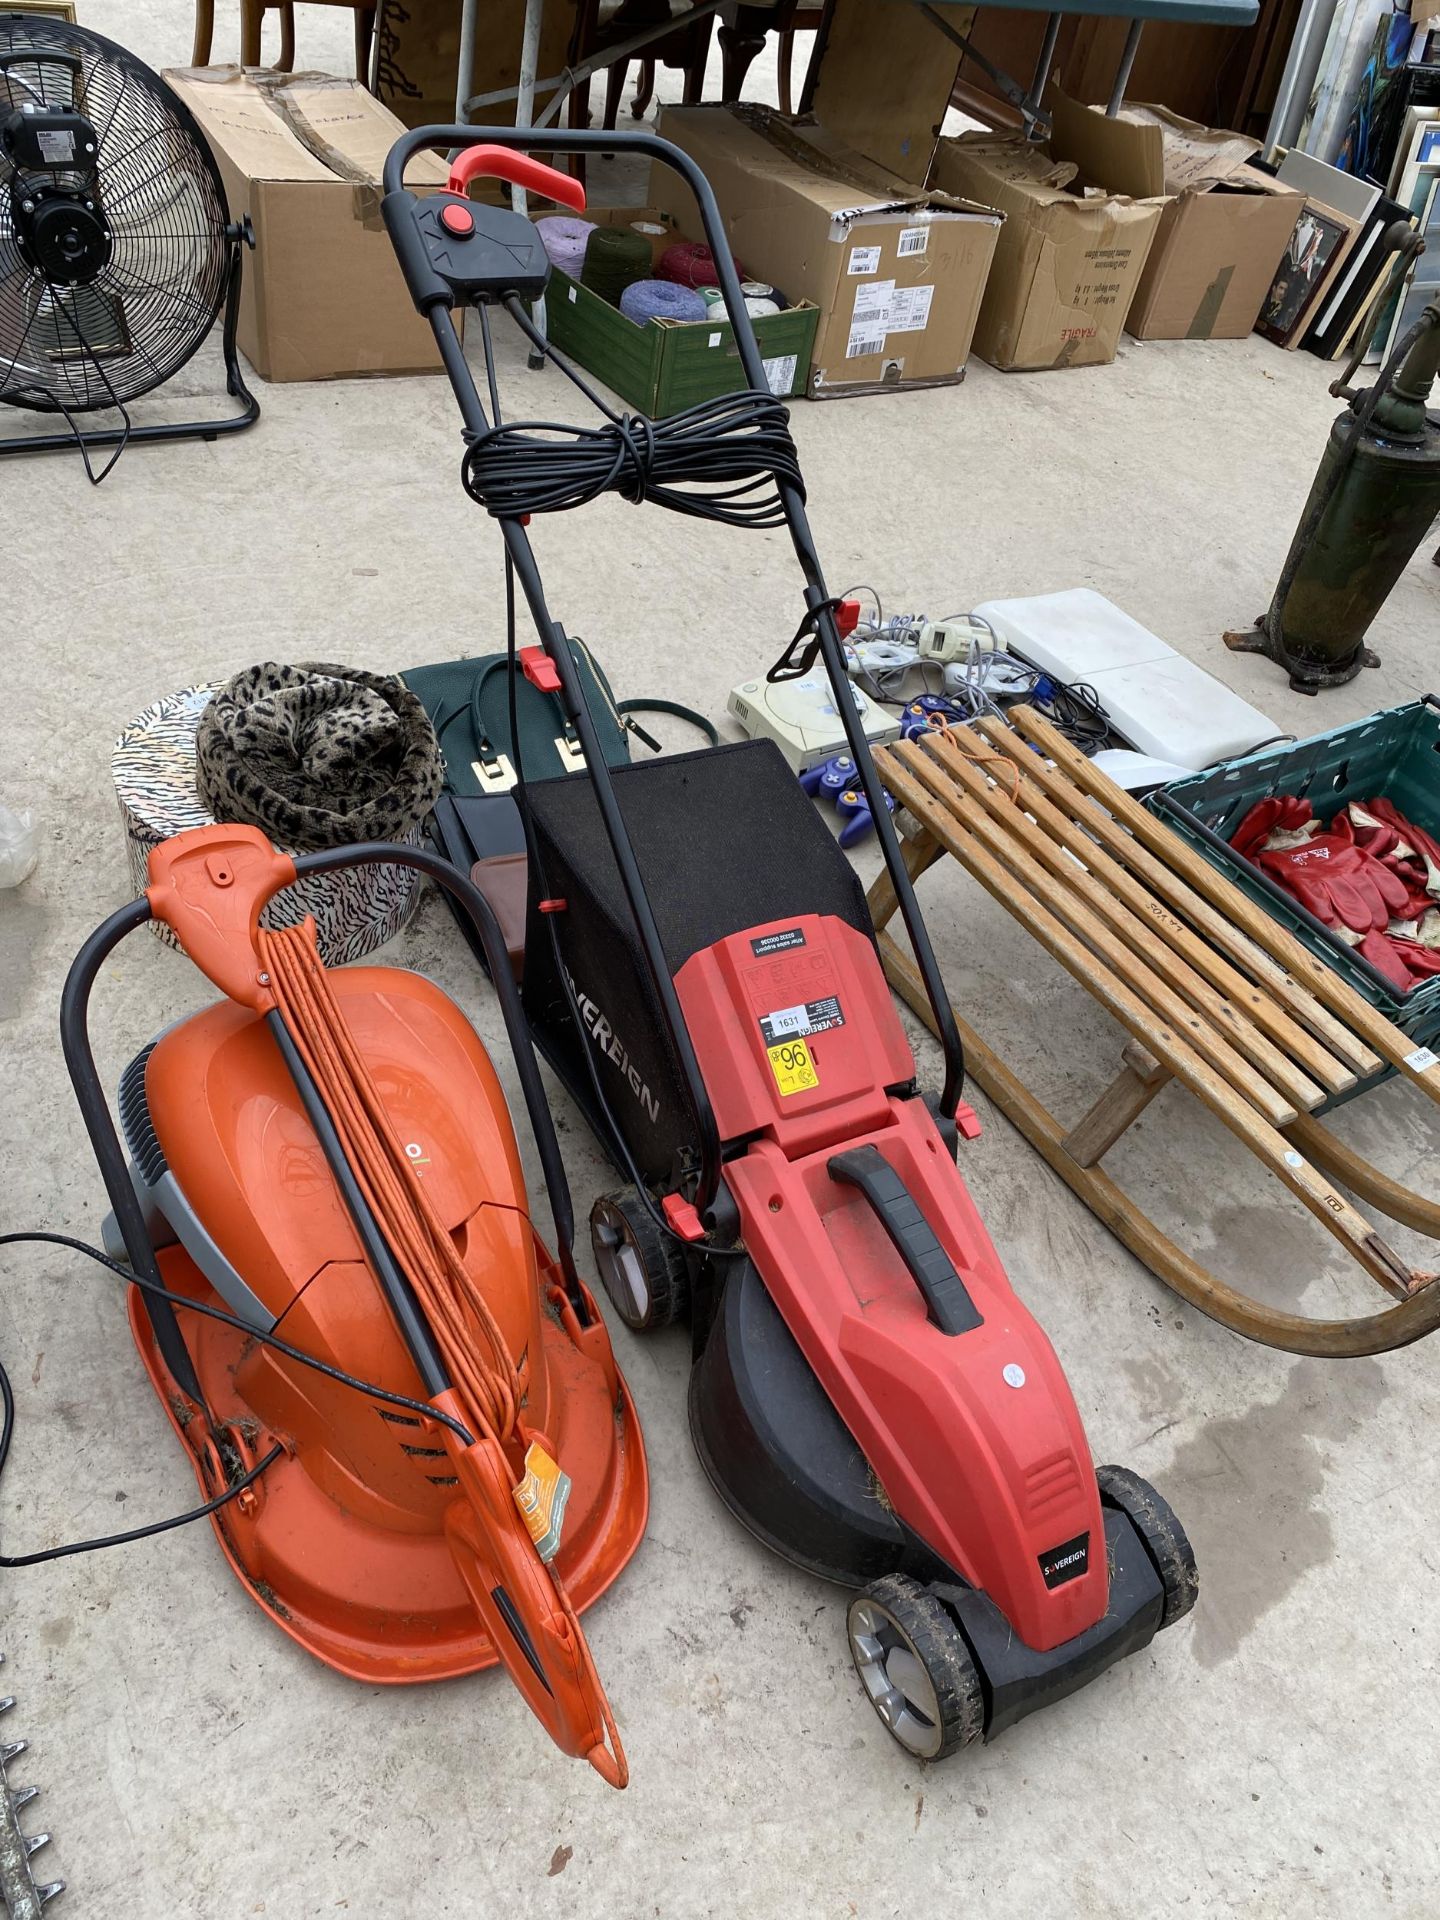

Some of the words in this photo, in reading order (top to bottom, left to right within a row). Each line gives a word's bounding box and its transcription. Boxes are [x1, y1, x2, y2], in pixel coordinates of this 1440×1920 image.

[1060, 328, 1097, 340] FRAGILE
[776, 940, 791, 948] sales
[790, 937, 804, 945] After
[755, 943, 776, 954] support
[778, 1015, 799, 1028] 1631
[798, 1016, 843, 1037] SOVEREIGN
[781, 1044, 806, 1071] 96
[1044, 1548, 1086, 1575] SOVEREIGN
